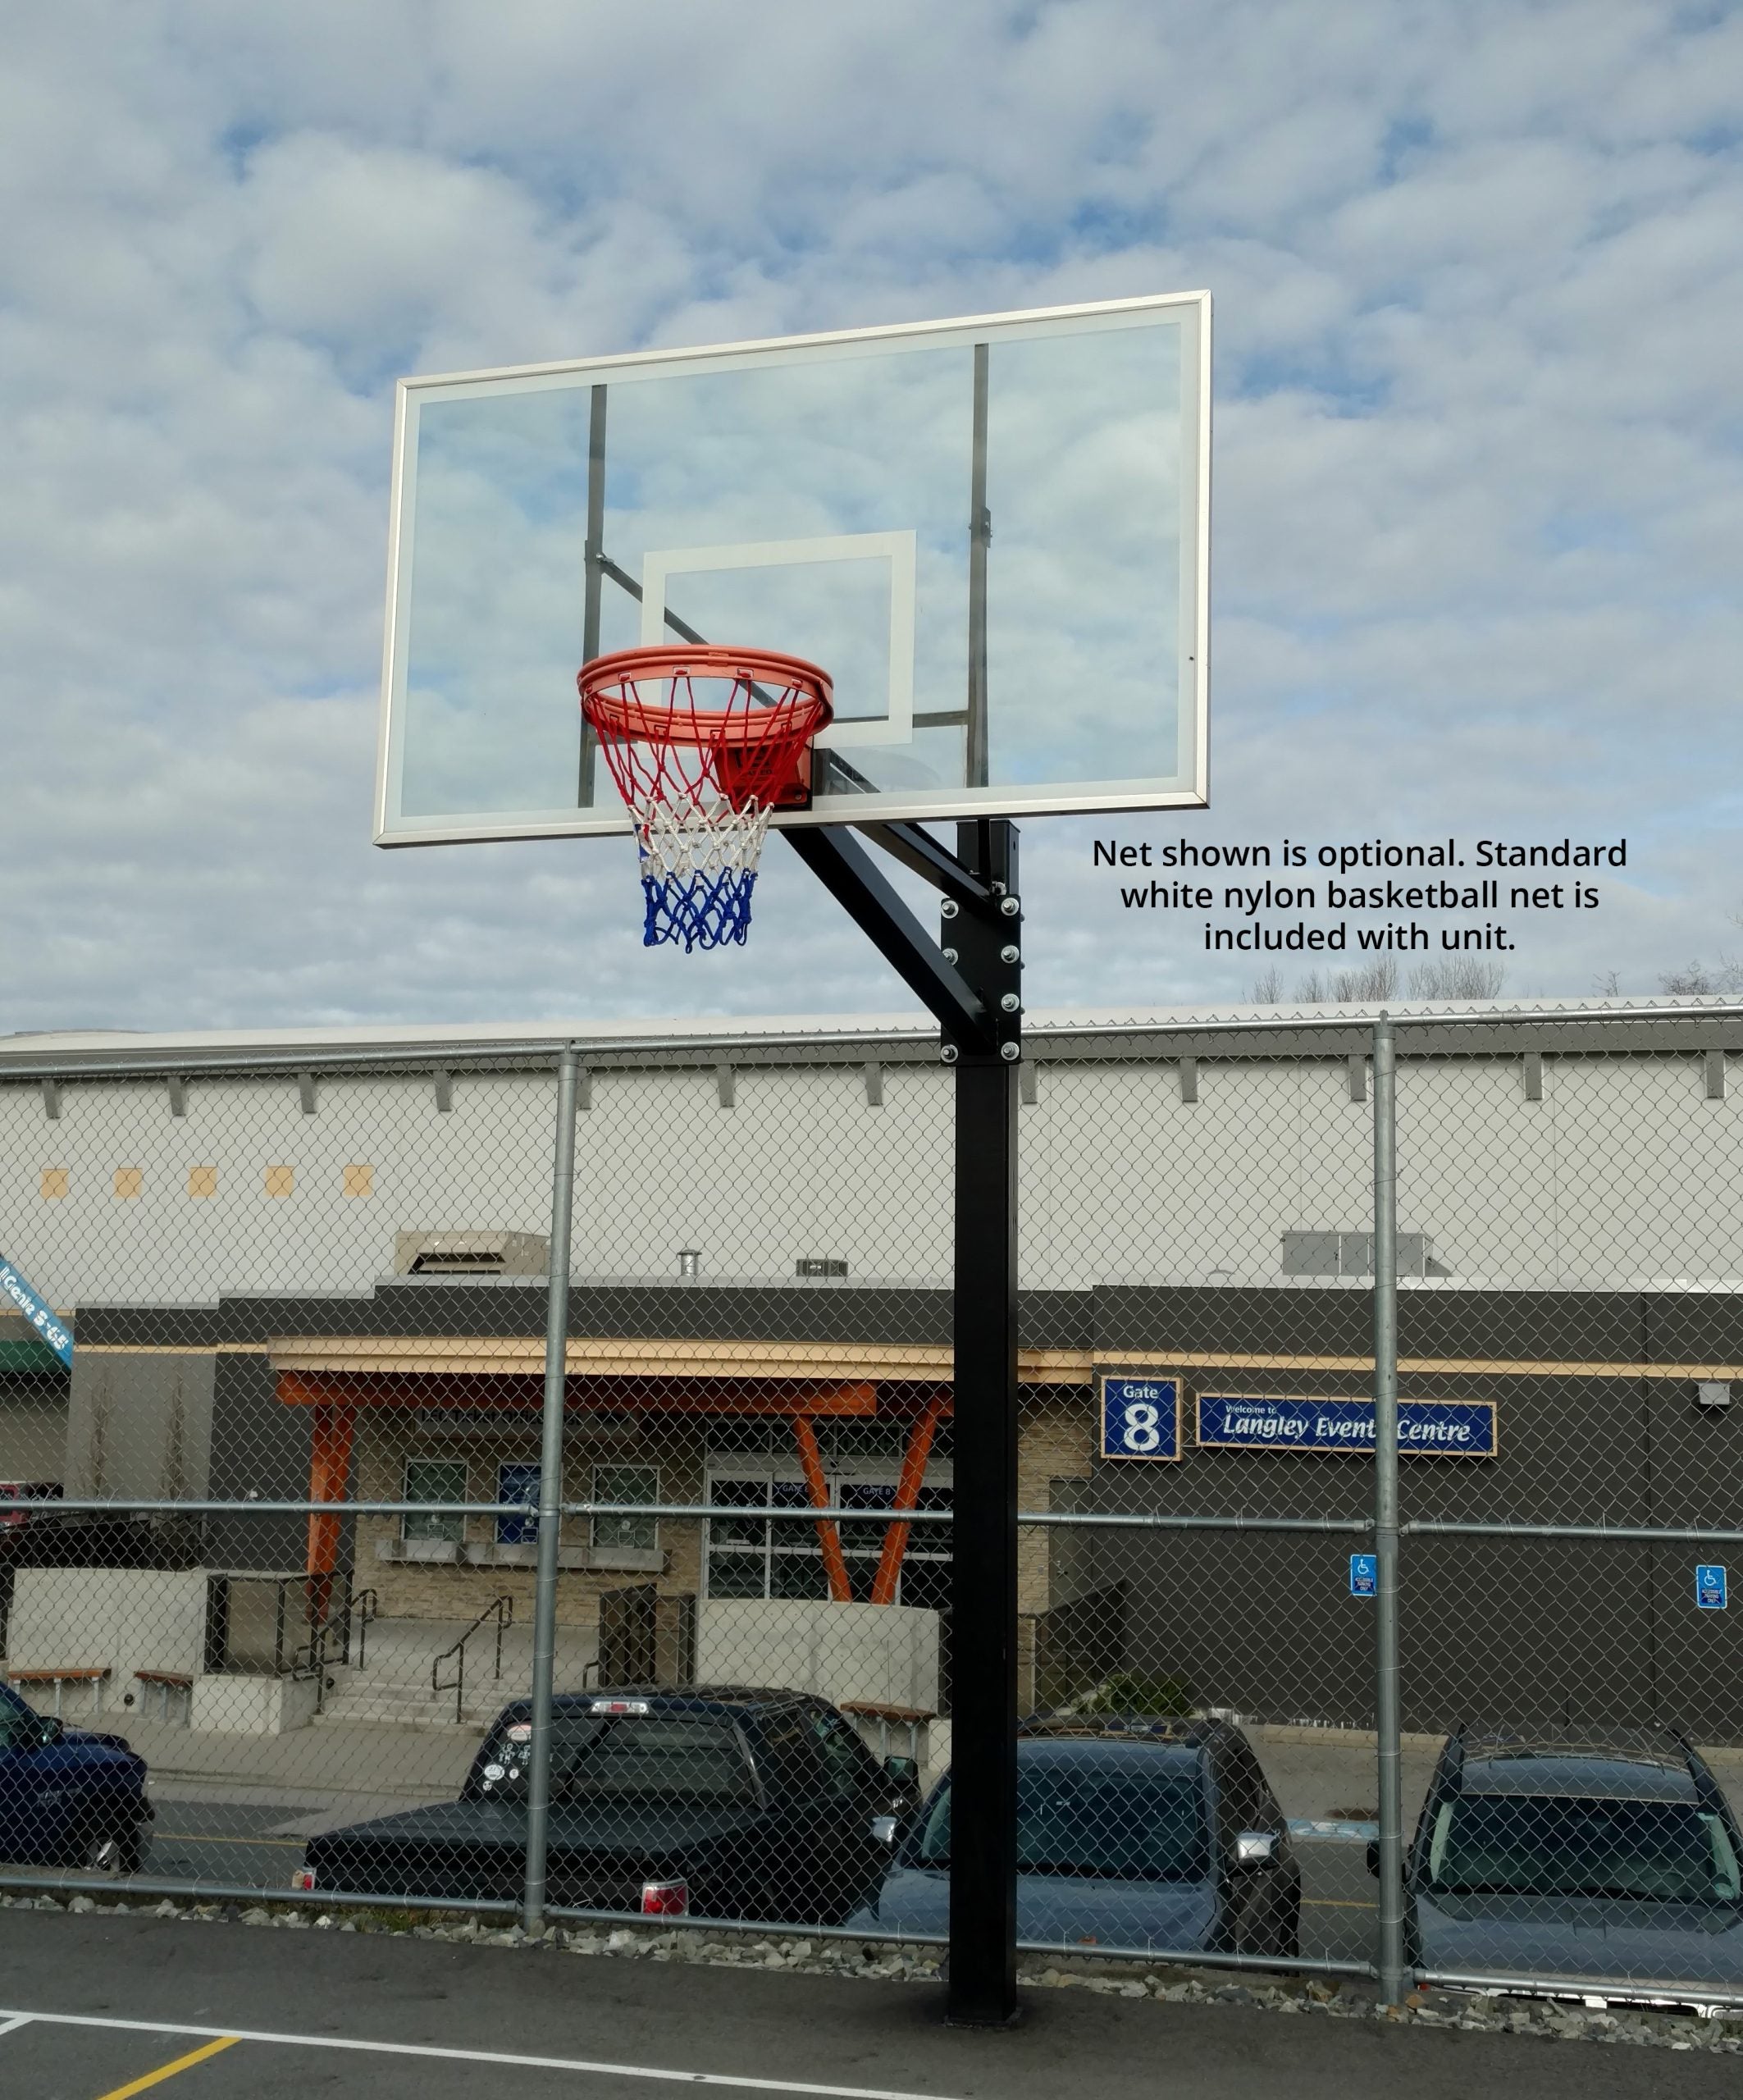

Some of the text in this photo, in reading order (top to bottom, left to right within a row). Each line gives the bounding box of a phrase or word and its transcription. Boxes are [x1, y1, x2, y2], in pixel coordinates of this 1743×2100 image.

[3, 1276, 35, 1316] Genie
[1123, 1386, 1159, 1399] Gate
[1225, 1405, 1277, 1414] Welcome to
[452, 1409, 498, 1424] Ticket
[502, 1409, 545, 1425] Office
[1123, 1404, 1160, 1451] 8
[1223, 1414, 1471, 1442] Langley Event Centre
[783, 1484, 802, 1493] GATE
[863, 1487, 891, 1495] GATE 8
